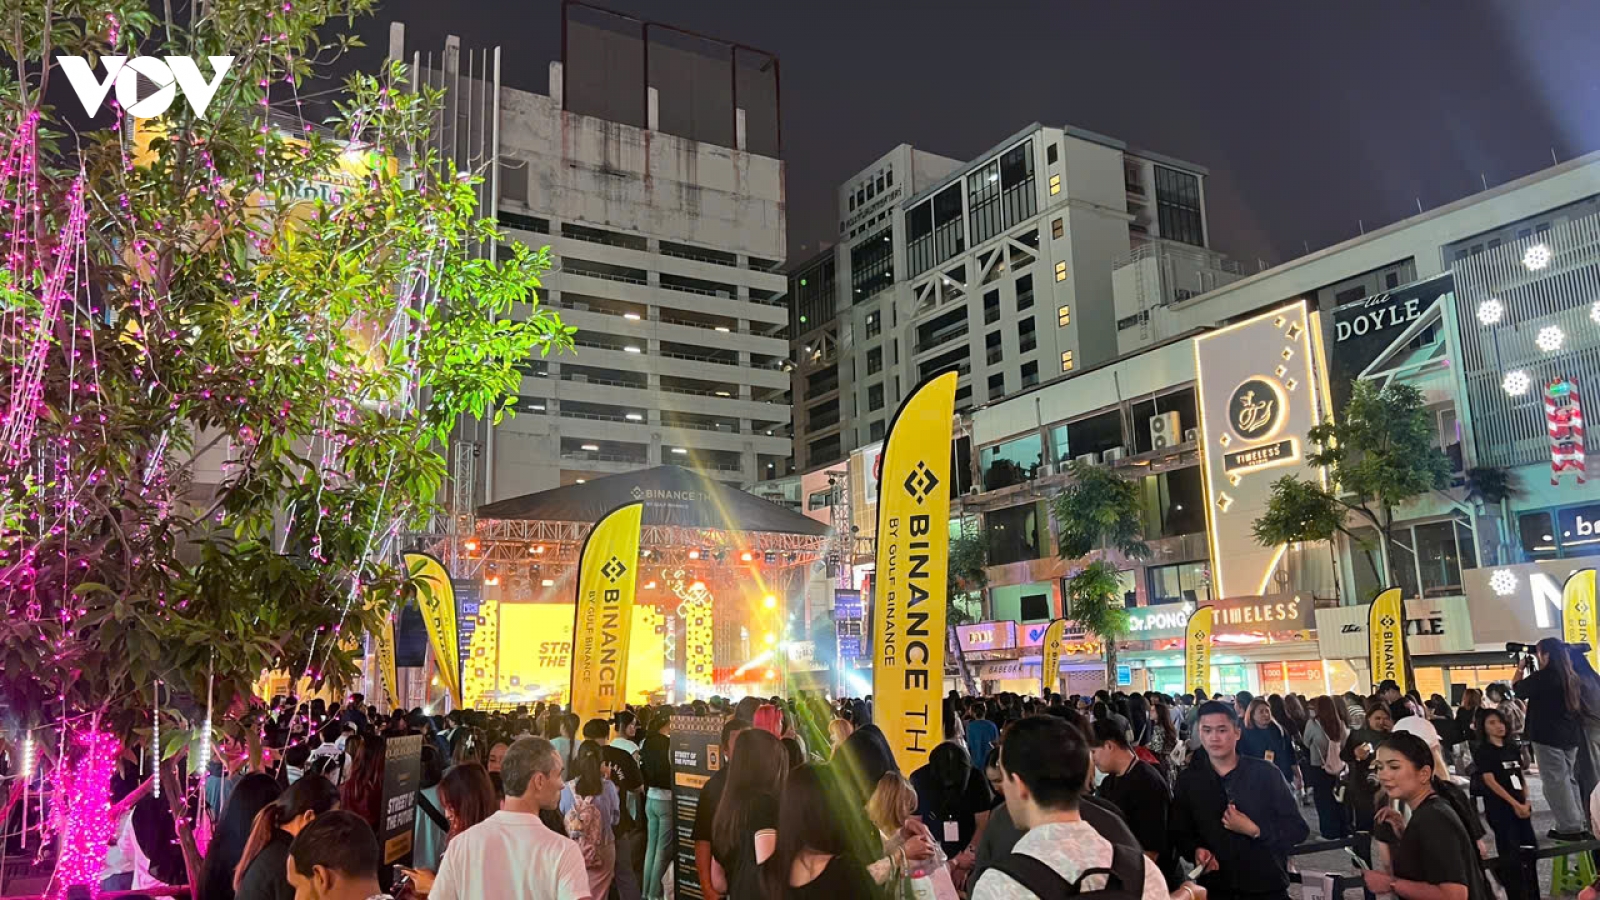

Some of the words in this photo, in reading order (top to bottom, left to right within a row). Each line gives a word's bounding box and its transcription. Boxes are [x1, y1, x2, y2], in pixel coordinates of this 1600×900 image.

[1364, 293, 1390, 308] the
[1336, 299, 1420, 342] DOYLE
[1236, 447, 1281, 464] TIMELESS
[645, 490, 696, 501] BINANCE
[889, 518, 899, 537] BY
[888, 544, 896, 586] GULF
[588, 591, 595, 603] BY
[905, 515, 930, 690] BINANCE
[585, 607, 595, 634] GULF
[1129, 611, 1187, 631] Dr.PONG
[1211, 602, 1298, 625] TIMELESS
[884, 591, 896, 666] BINANCE
[598, 589, 619, 696] BINANCE
[540, 656, 568, 667] THE
[583, 636, 594, 683] BINANCE
[1196, 644, 1204, 687] BINANC
[1383, 632, 1395, 679] BINANC
[598, 704, 614, 719] T
[905, 704, 928, 752] TH
[388, 793, 408, 815] STREET
[386, 814, 397, 831] THE
